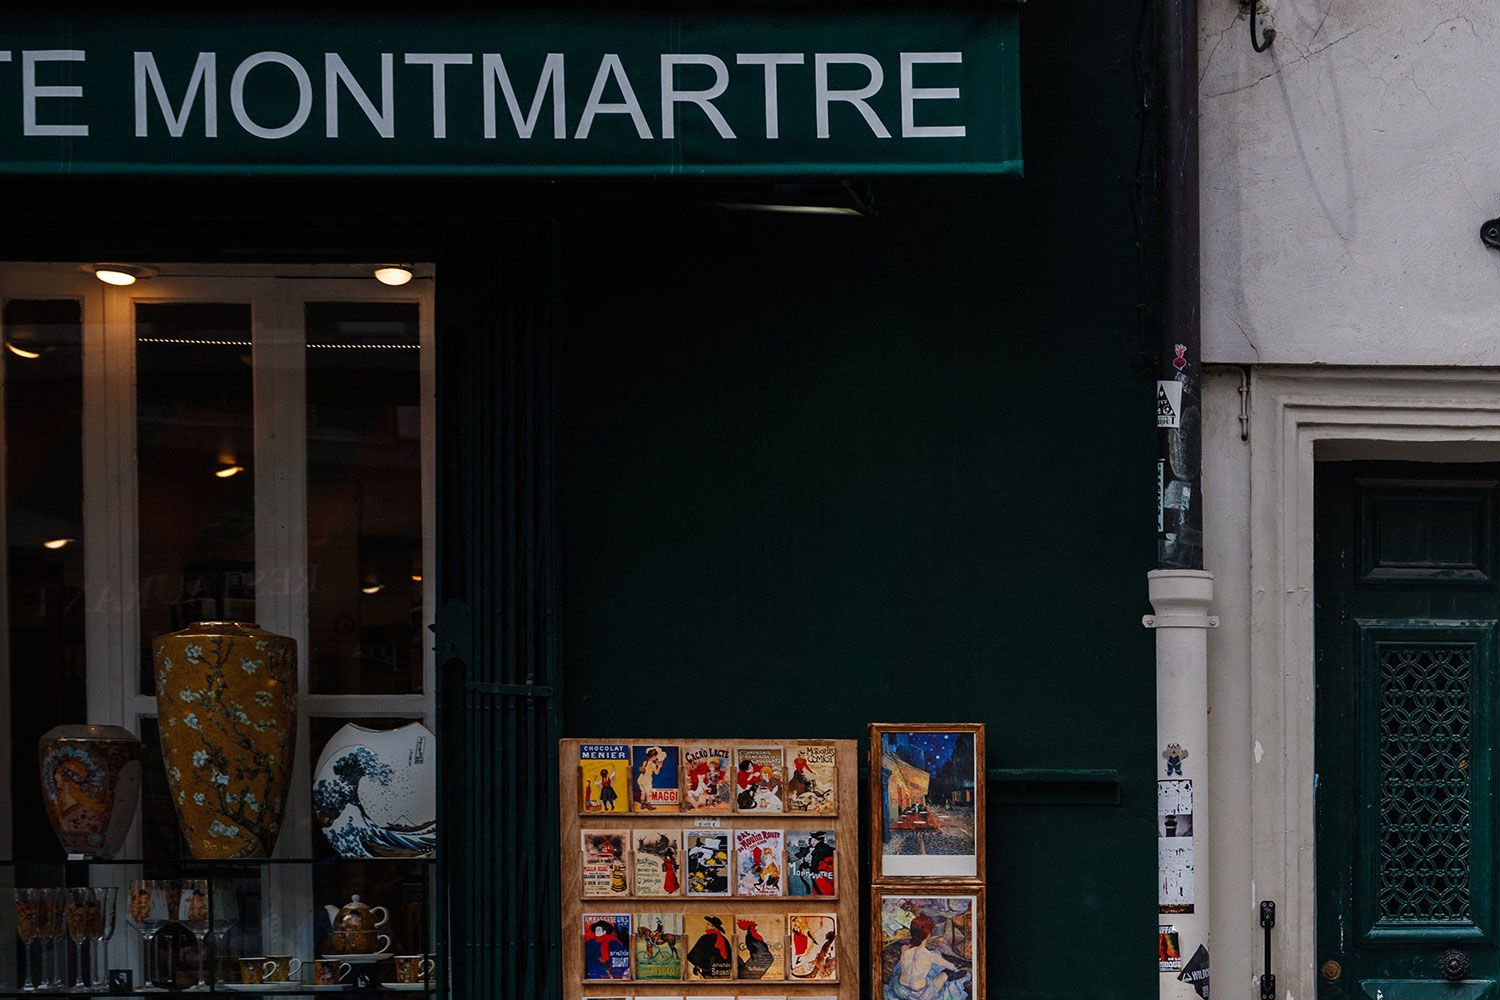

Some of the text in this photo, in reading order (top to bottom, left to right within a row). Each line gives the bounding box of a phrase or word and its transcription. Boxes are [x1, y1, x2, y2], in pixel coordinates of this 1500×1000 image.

[0, 50, 968, 139] E MONTMARTRE
[582, 751, 626, 759] MENIER
[685, 749, 708, 762] CACAO
[651, 791, 678, 801] MAGGI
